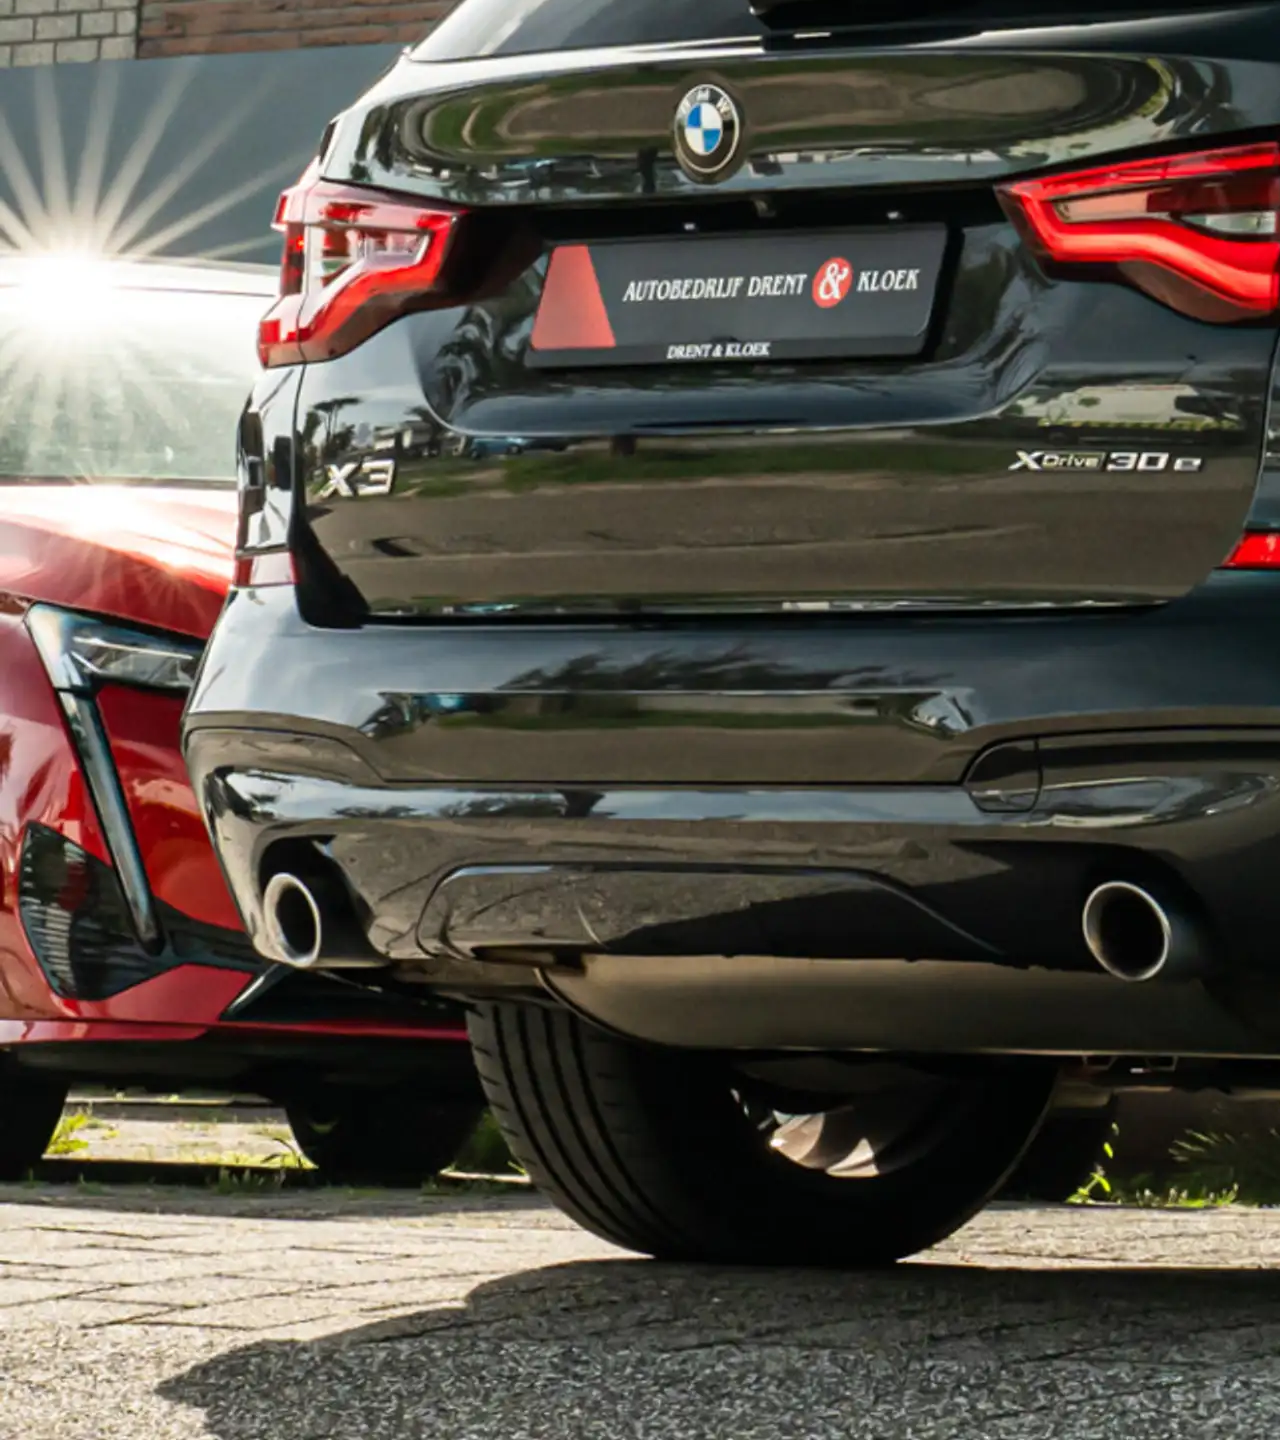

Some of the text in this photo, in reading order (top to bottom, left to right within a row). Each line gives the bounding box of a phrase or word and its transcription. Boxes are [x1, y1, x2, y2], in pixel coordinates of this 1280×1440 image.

[622, 262, 921, 302] AUTOBEDRIJF DRENT & KLOEK
[666, 341, 771, 360] DRENT & KLOEK
[319, 459, 395, 498] X3
